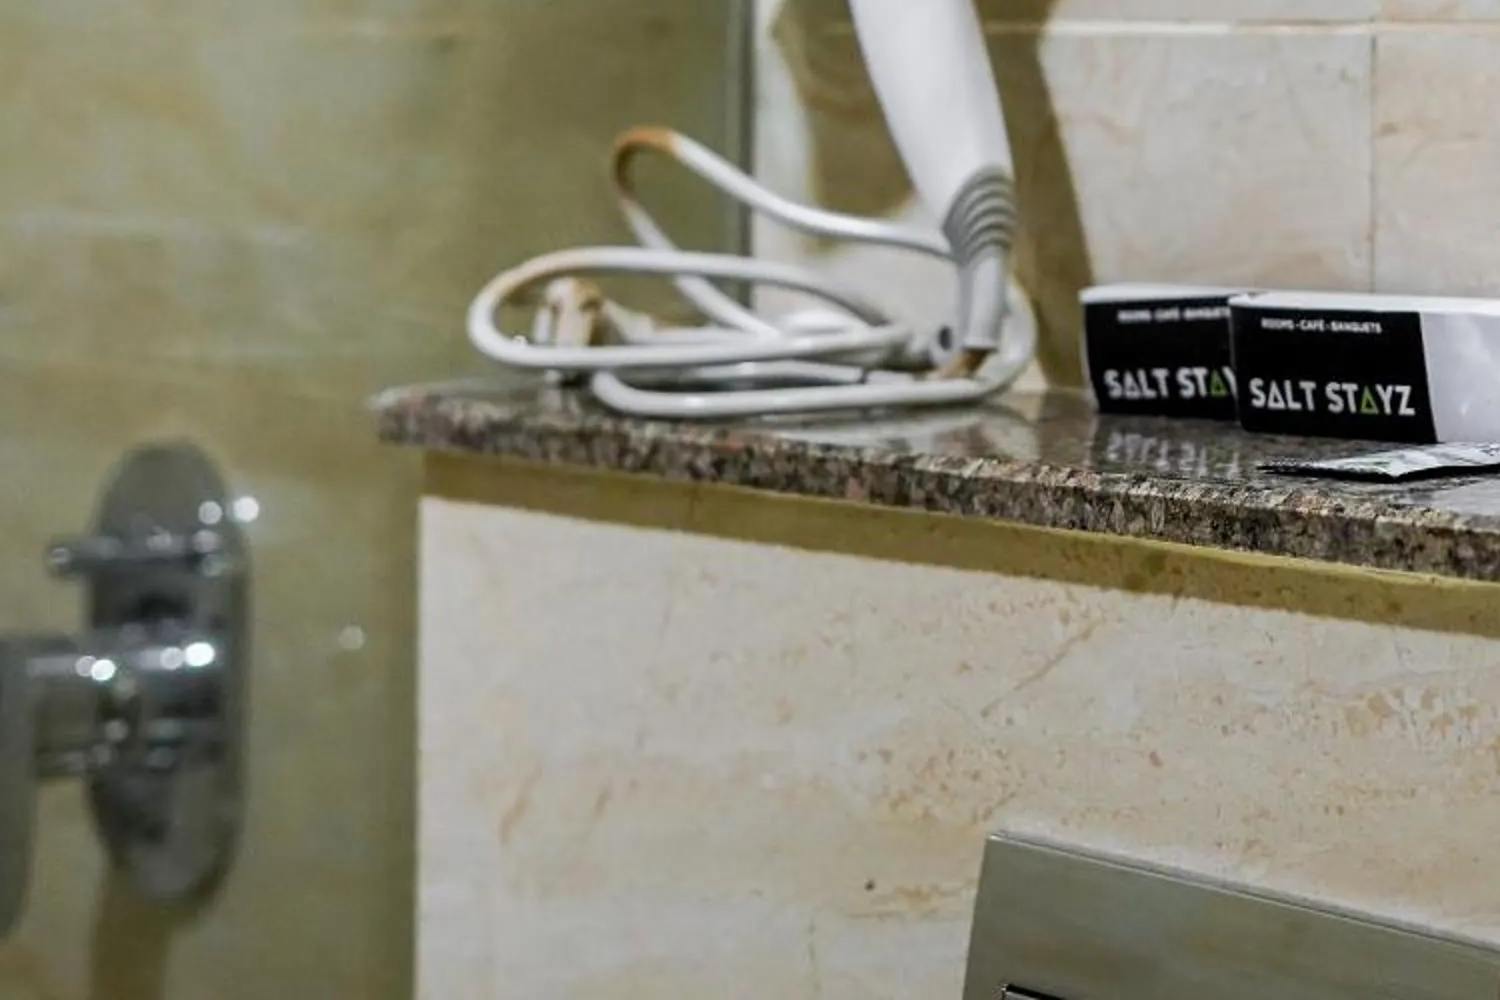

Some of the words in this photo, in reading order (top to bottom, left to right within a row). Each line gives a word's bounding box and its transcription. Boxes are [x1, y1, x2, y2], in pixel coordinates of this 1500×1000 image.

[1103, 367, 1170, 400] SALT
[1249, 377, 1317, 411] SALT
[1325, 381, 1416, 416] STAYZ
